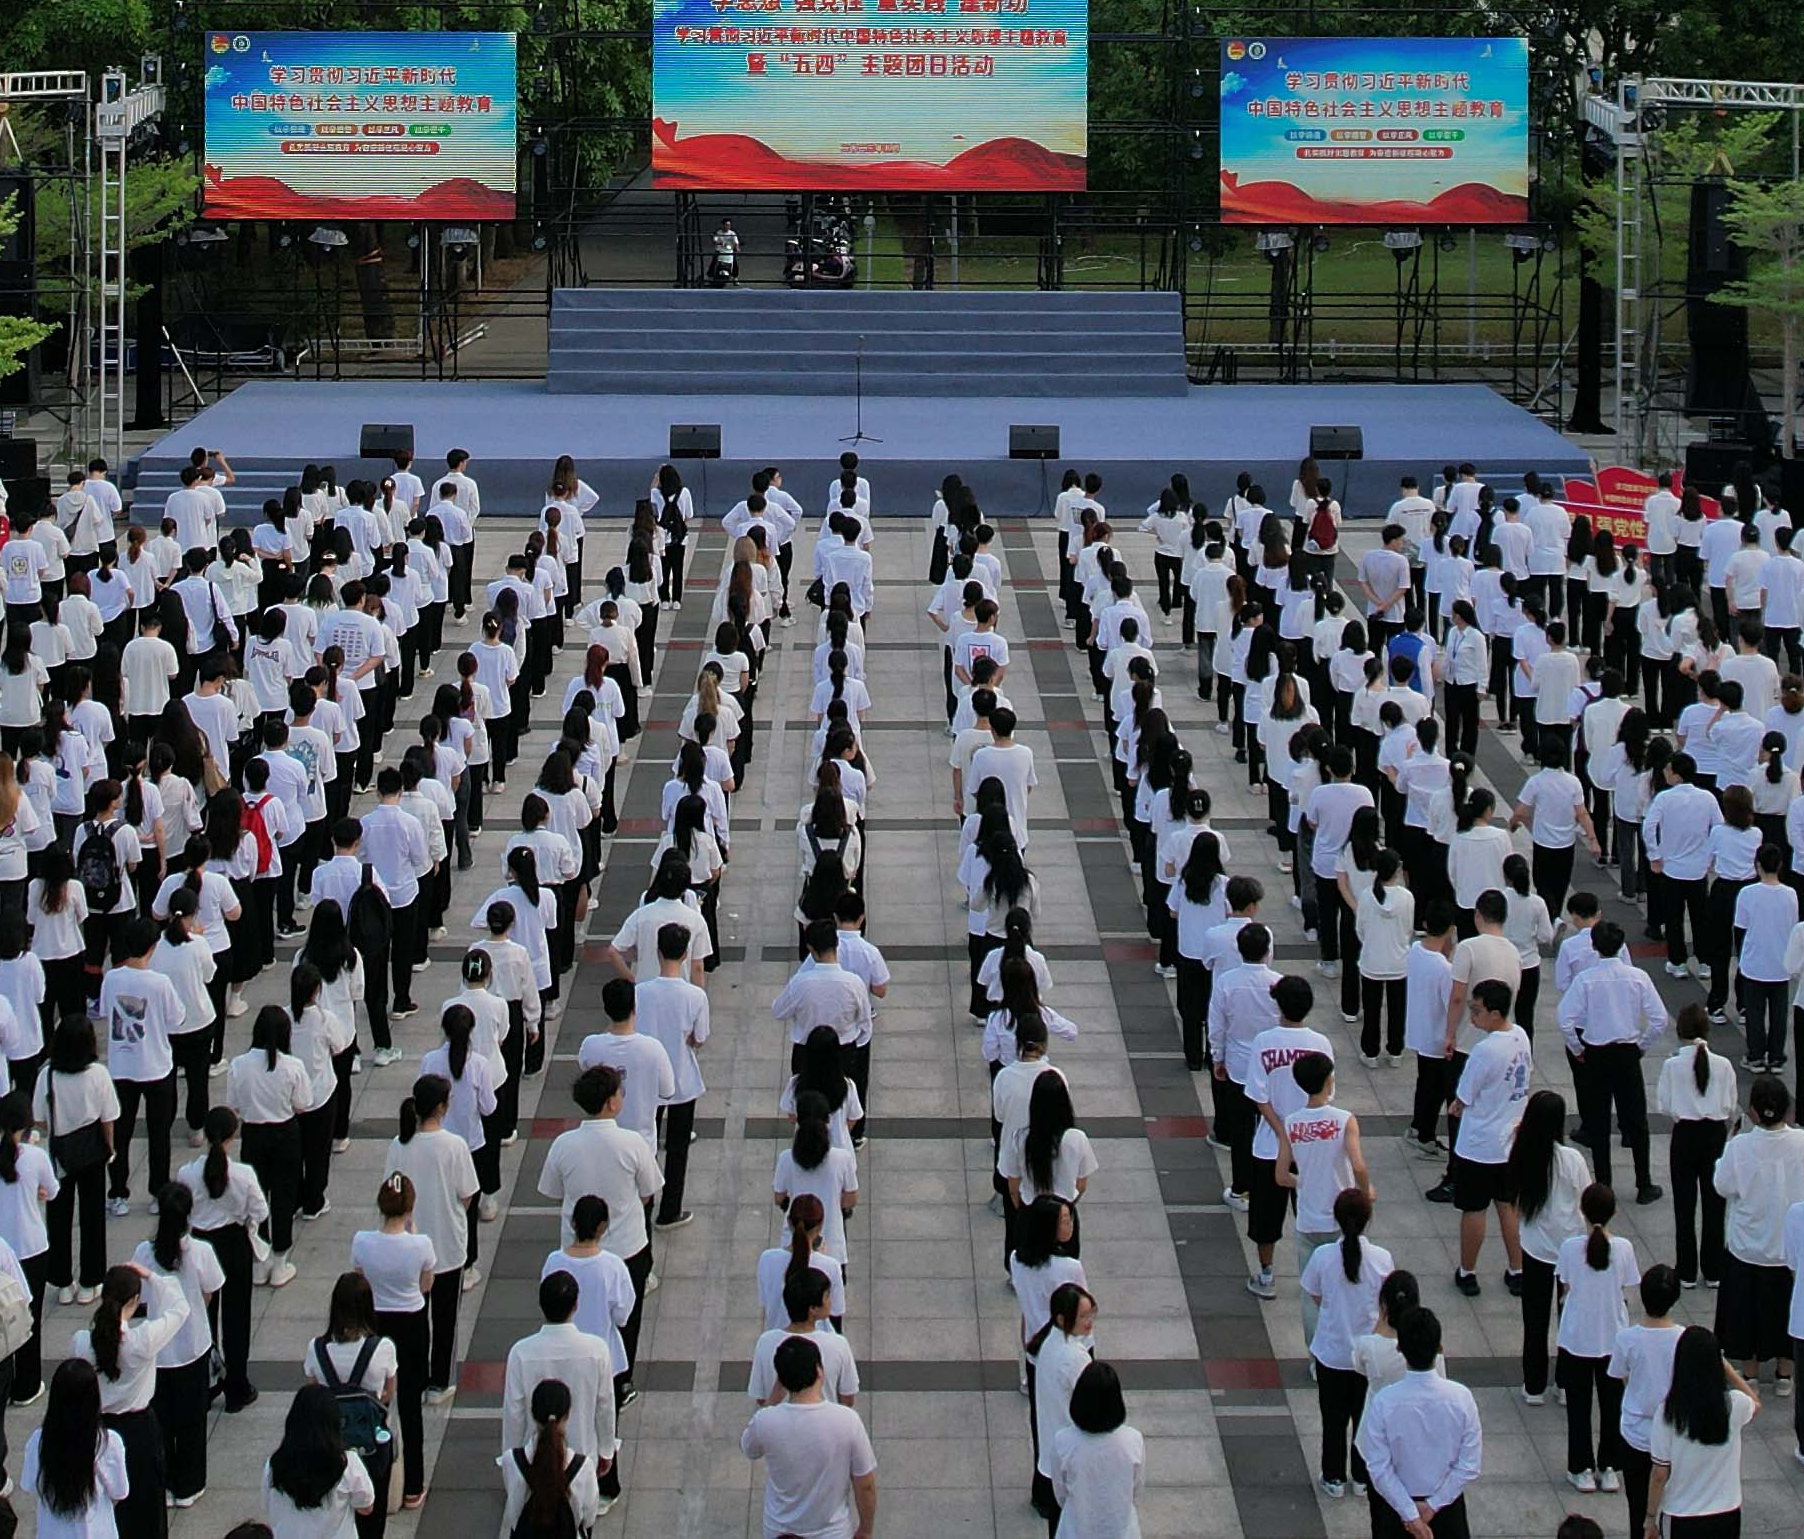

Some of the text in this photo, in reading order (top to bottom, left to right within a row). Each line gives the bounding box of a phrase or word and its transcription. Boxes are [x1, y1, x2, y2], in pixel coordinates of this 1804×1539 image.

[269, 66, 457, 86] 学习贯彻习近平新时代
[1285, 72, 1469, 91] 学习贯彻习近平新时代
[232, 93, 492, 114] 中国特色社会主义思想主题教育
[1248, 99, 1505, 119] 中国特色社会主义思想主题教育
